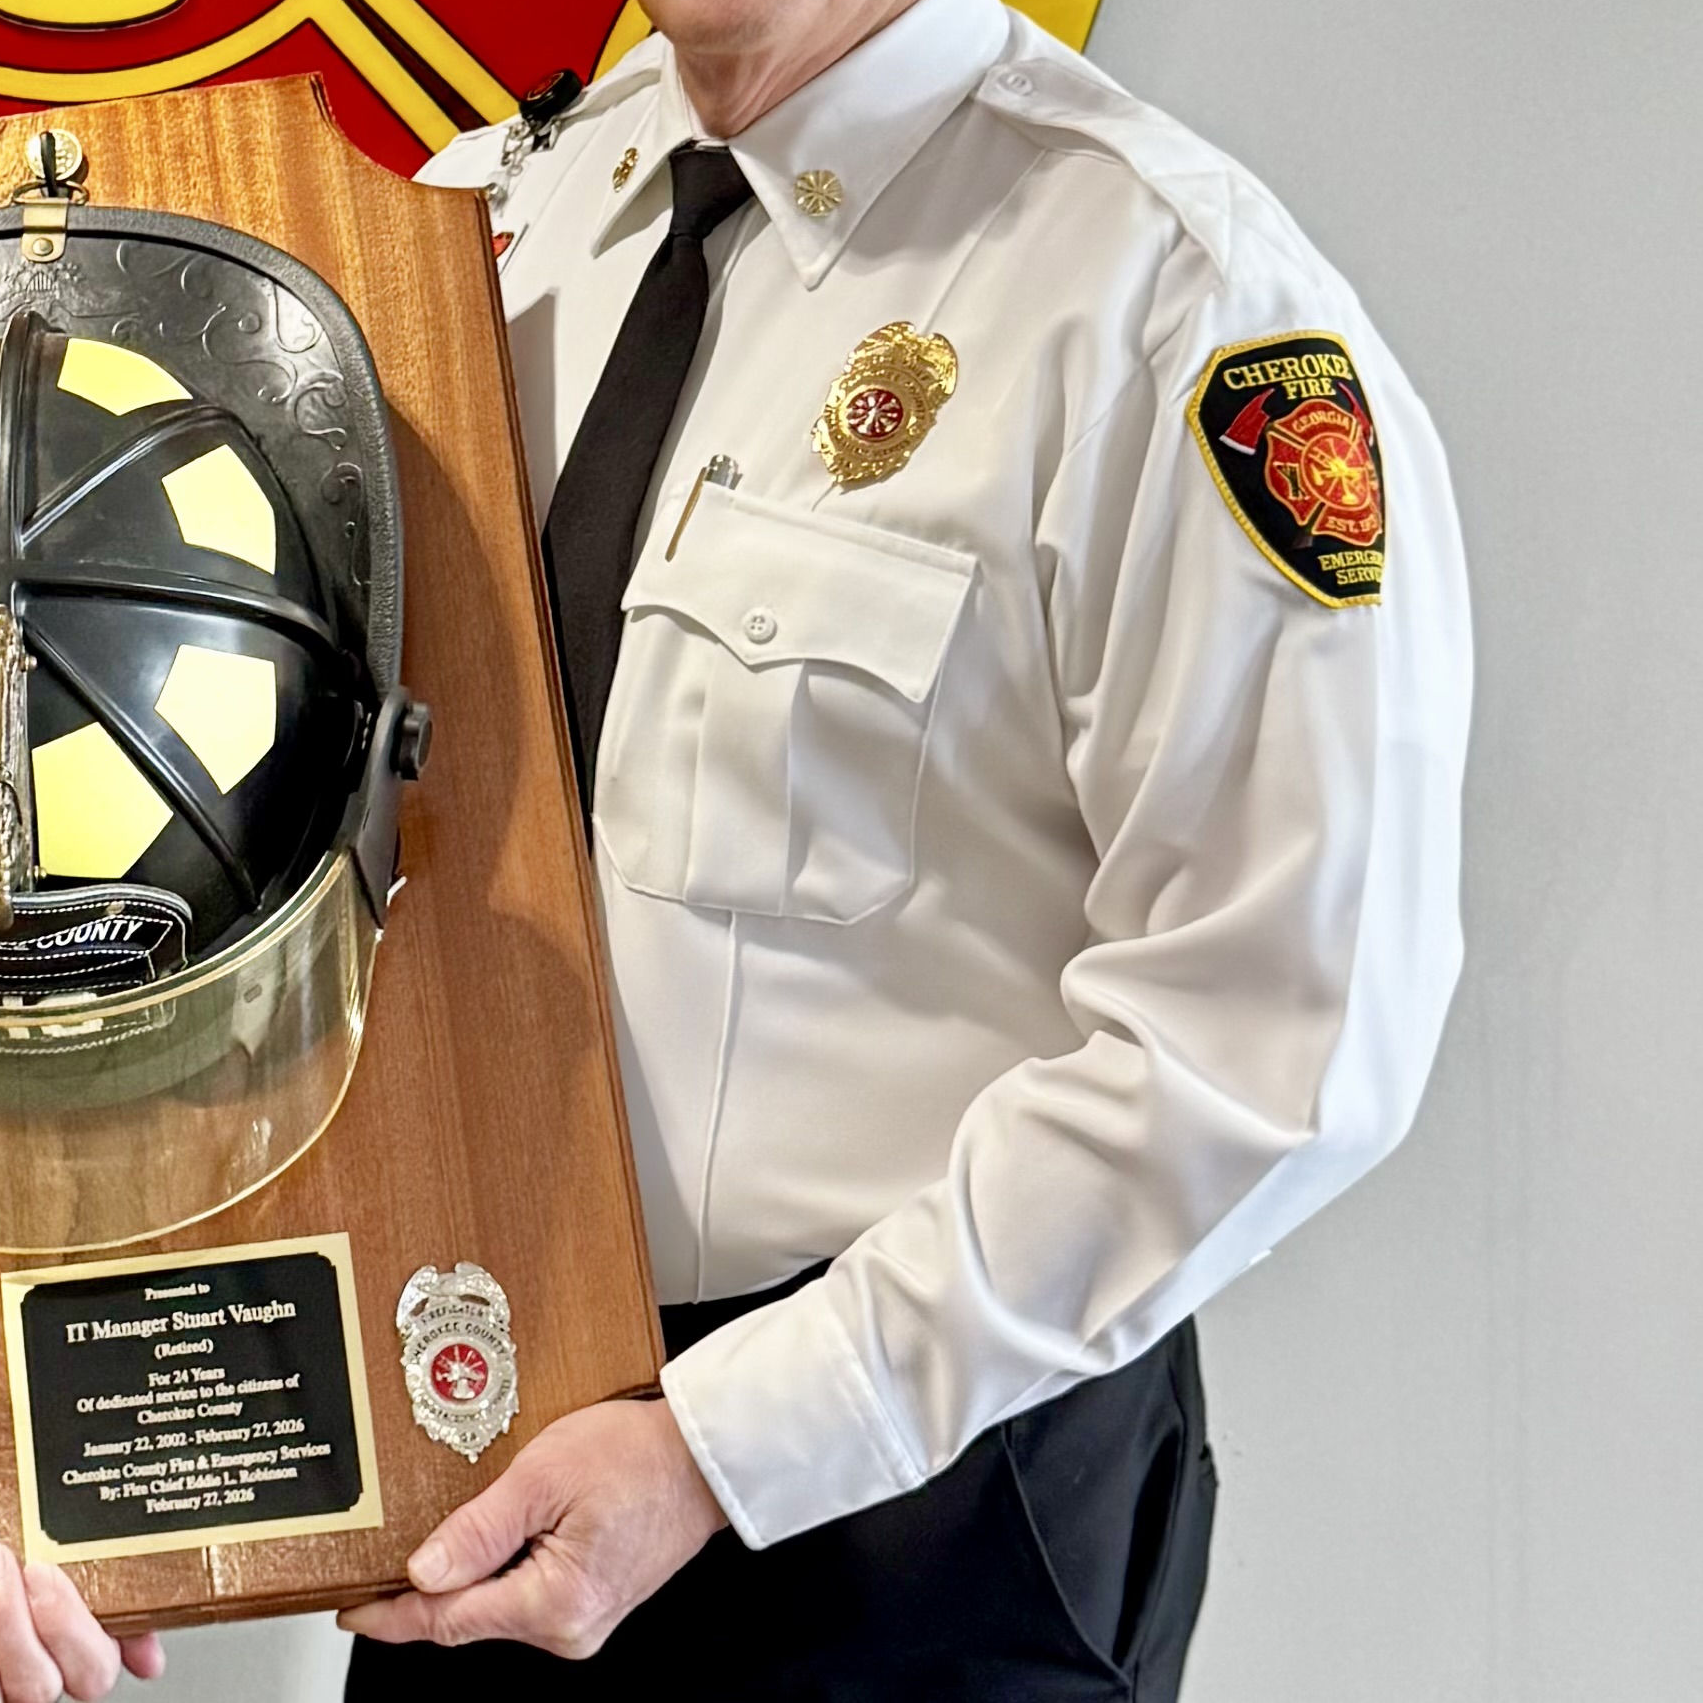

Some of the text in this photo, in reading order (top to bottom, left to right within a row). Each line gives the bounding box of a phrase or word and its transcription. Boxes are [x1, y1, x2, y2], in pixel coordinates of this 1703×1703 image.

[1282, 378, 1336, 399] FIRE
[1292, 410, 1350, 432] GEORGIA
[36, 919, 143, 949] COUNTY
[144, 1283, 210, 1300] Presented to
[66, 1300, 296, 1343] IT Manager Stuart Vaughn
[154, 1338, 214, 1359] (Retired)
[148, 1367, 225, 1387] For 24 Years
[77, 1373, 300, 1413] Of dedicated service to the citizens of
[137, 1401, 243, 1425] Cherokee County
[83, 1440, 132, 1457] January
[133, 1435, 154, 1452] 22,
[155, 1432, 187, 1449] 2002
[195, 1428, 251, 1445] February
[252, 1422, 272, 1438] 27,
[272, 1418, 305, 1435] 2026
[62, 1442, 331, 1485] Cherokee County Fire & Emergency Services
[99, 1486, 122, 1501] By:
[122, 1482, 149, 1498] Fire
[150, 1476, 185, 1494] Chief
[186, 1473, 222, 1490] Eddie
[239, 1467, 298, 1484] Robinson
[145, 1487, 255, 1513] February 27, 2026
